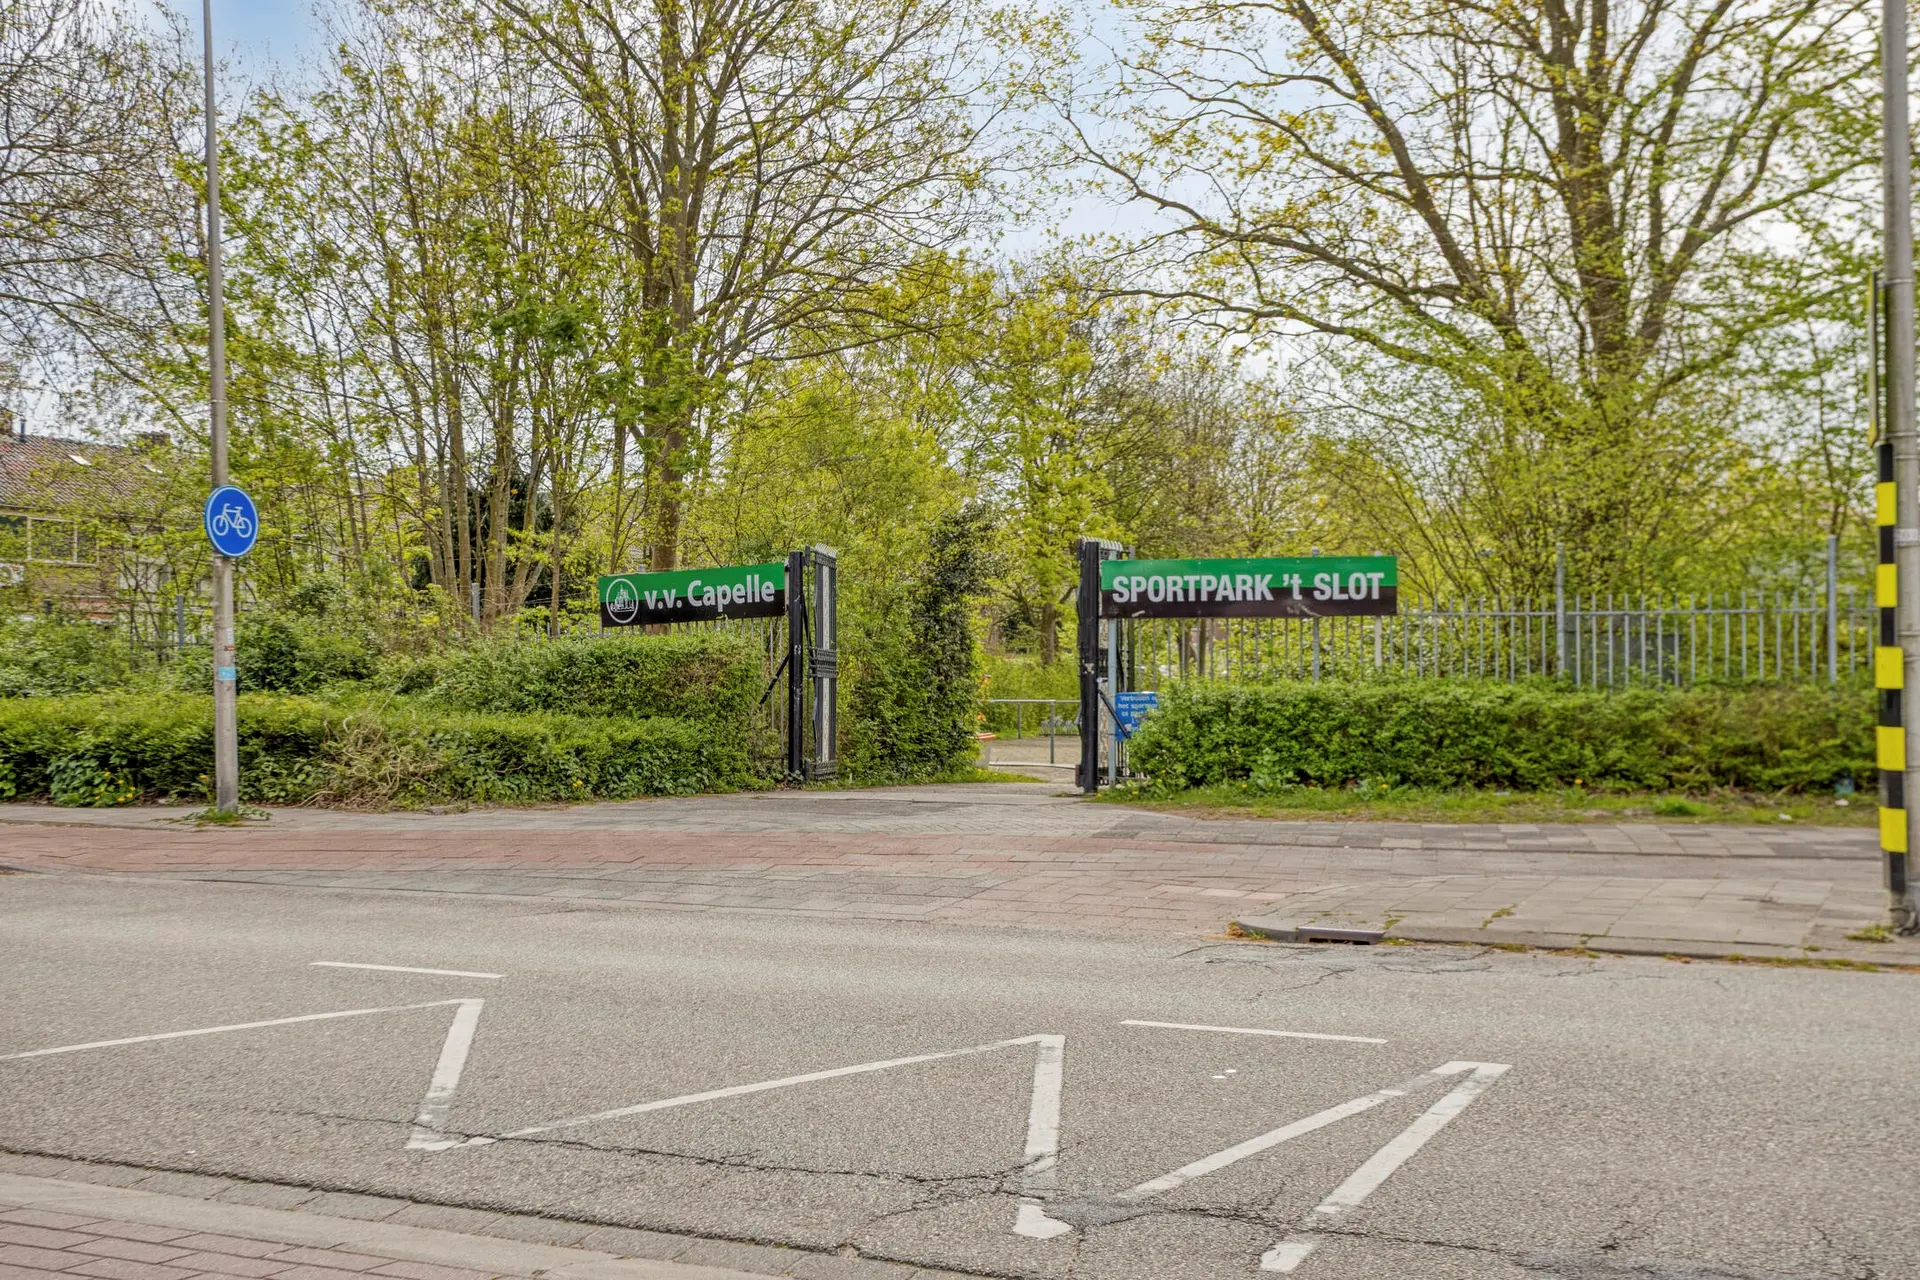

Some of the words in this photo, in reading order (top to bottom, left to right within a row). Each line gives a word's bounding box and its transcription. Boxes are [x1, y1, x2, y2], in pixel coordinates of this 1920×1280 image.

[644, 588, 682, 609] v.v.
[687, 574, 775, 612] Capelle
[1113, 575, 1273, 602] SPORTPARK
[1283, 573, 1302, 600] 't
[1313, 572, 1384, 600] SLOT
